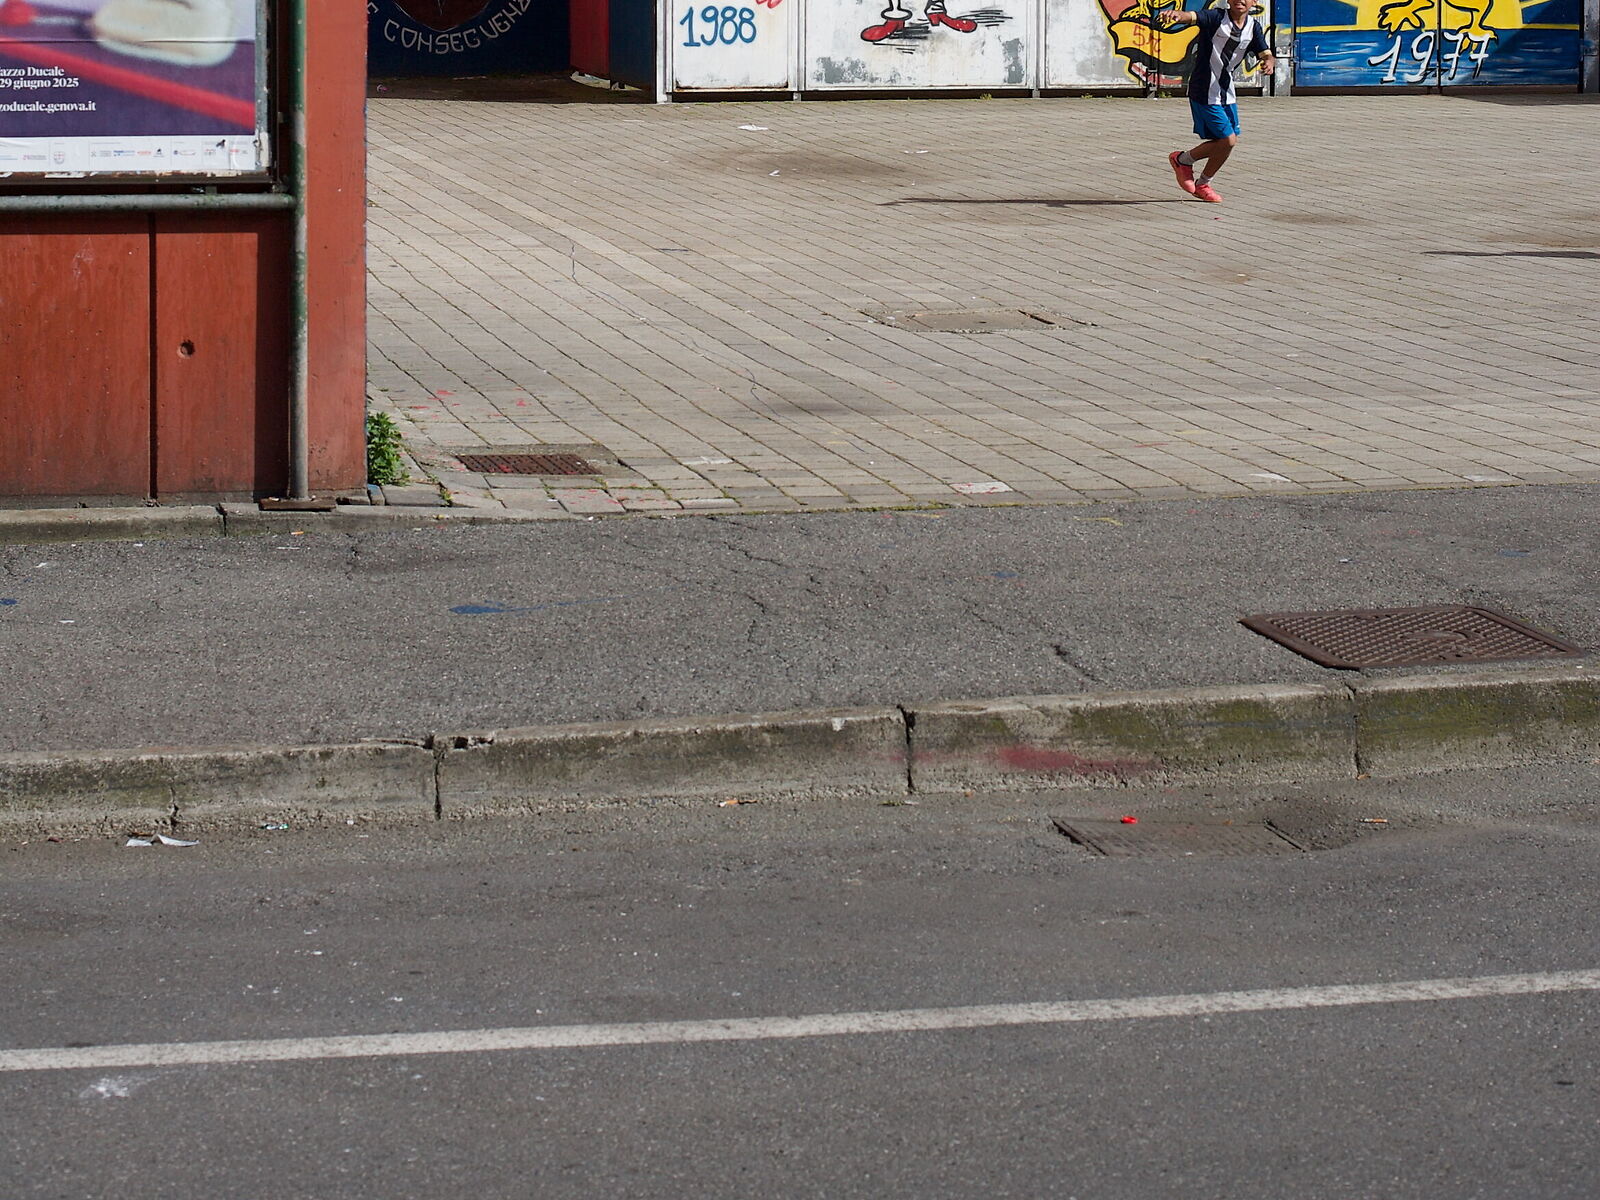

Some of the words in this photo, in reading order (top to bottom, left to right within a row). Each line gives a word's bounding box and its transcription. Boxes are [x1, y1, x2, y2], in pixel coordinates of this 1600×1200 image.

[679, 5, 757, 47] 1988
[0, 66, 25, 76] azzo
[27, 66, 65, 76] Ducale
[1367, 30, 1498, 86] 1977
[13, 77, 51, 90] giugno
[52, 78, 79, 88] 2025
